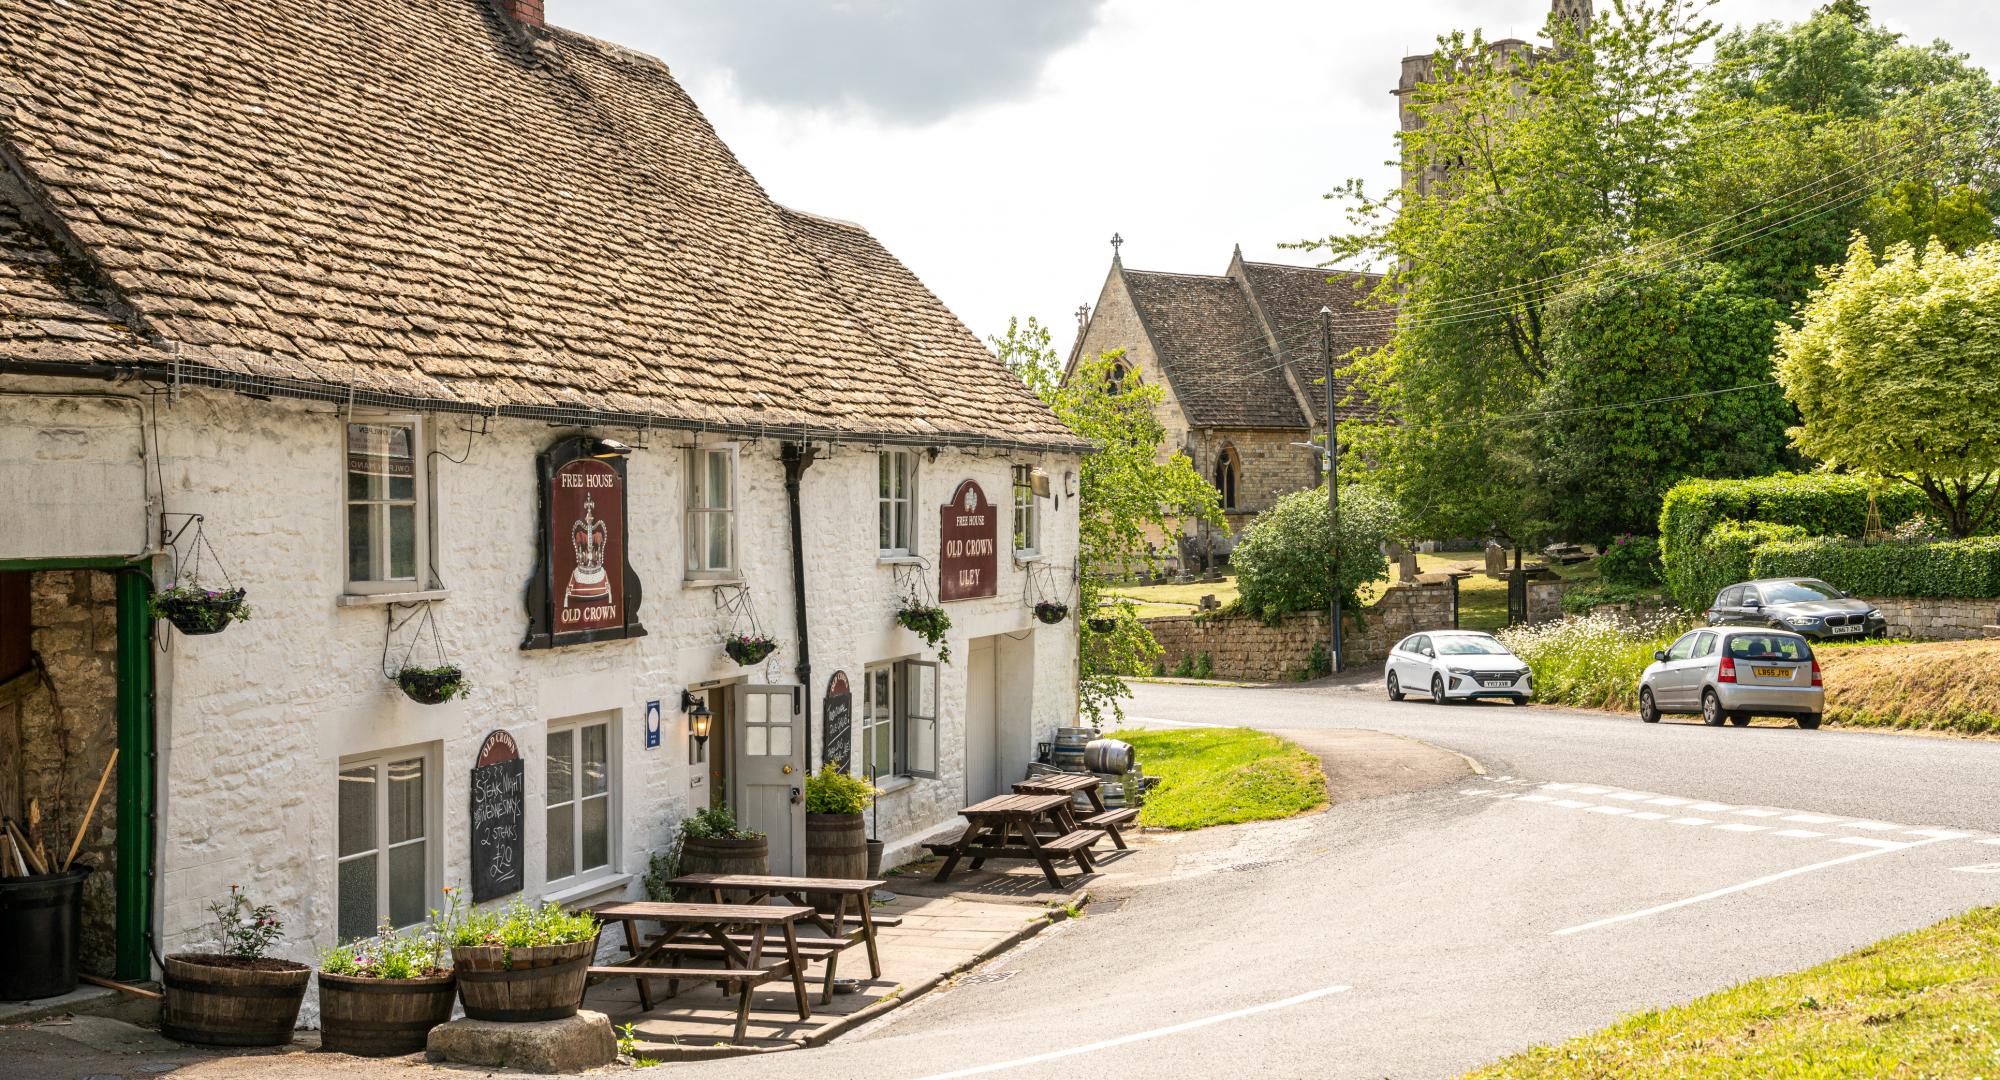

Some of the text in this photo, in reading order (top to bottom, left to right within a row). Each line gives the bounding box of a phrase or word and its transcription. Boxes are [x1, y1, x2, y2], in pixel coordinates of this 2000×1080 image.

[562, 474, 614, 488] FREE HOUSE
[956, 516, 984, 526] FREE HOUSE
[946, 538, 993, 558] OLD CROWN
[960, 568, 980, 586] ULEY
[562, 605, 616, 622] OLD CROWN
[483, 732, 515, 758] OLD CROWN
[476, 772, 522, 802] STEAK NIGHT
[480, 824, 517, 846] 2 STEAKS
[490, 843, 512, 878] £20
